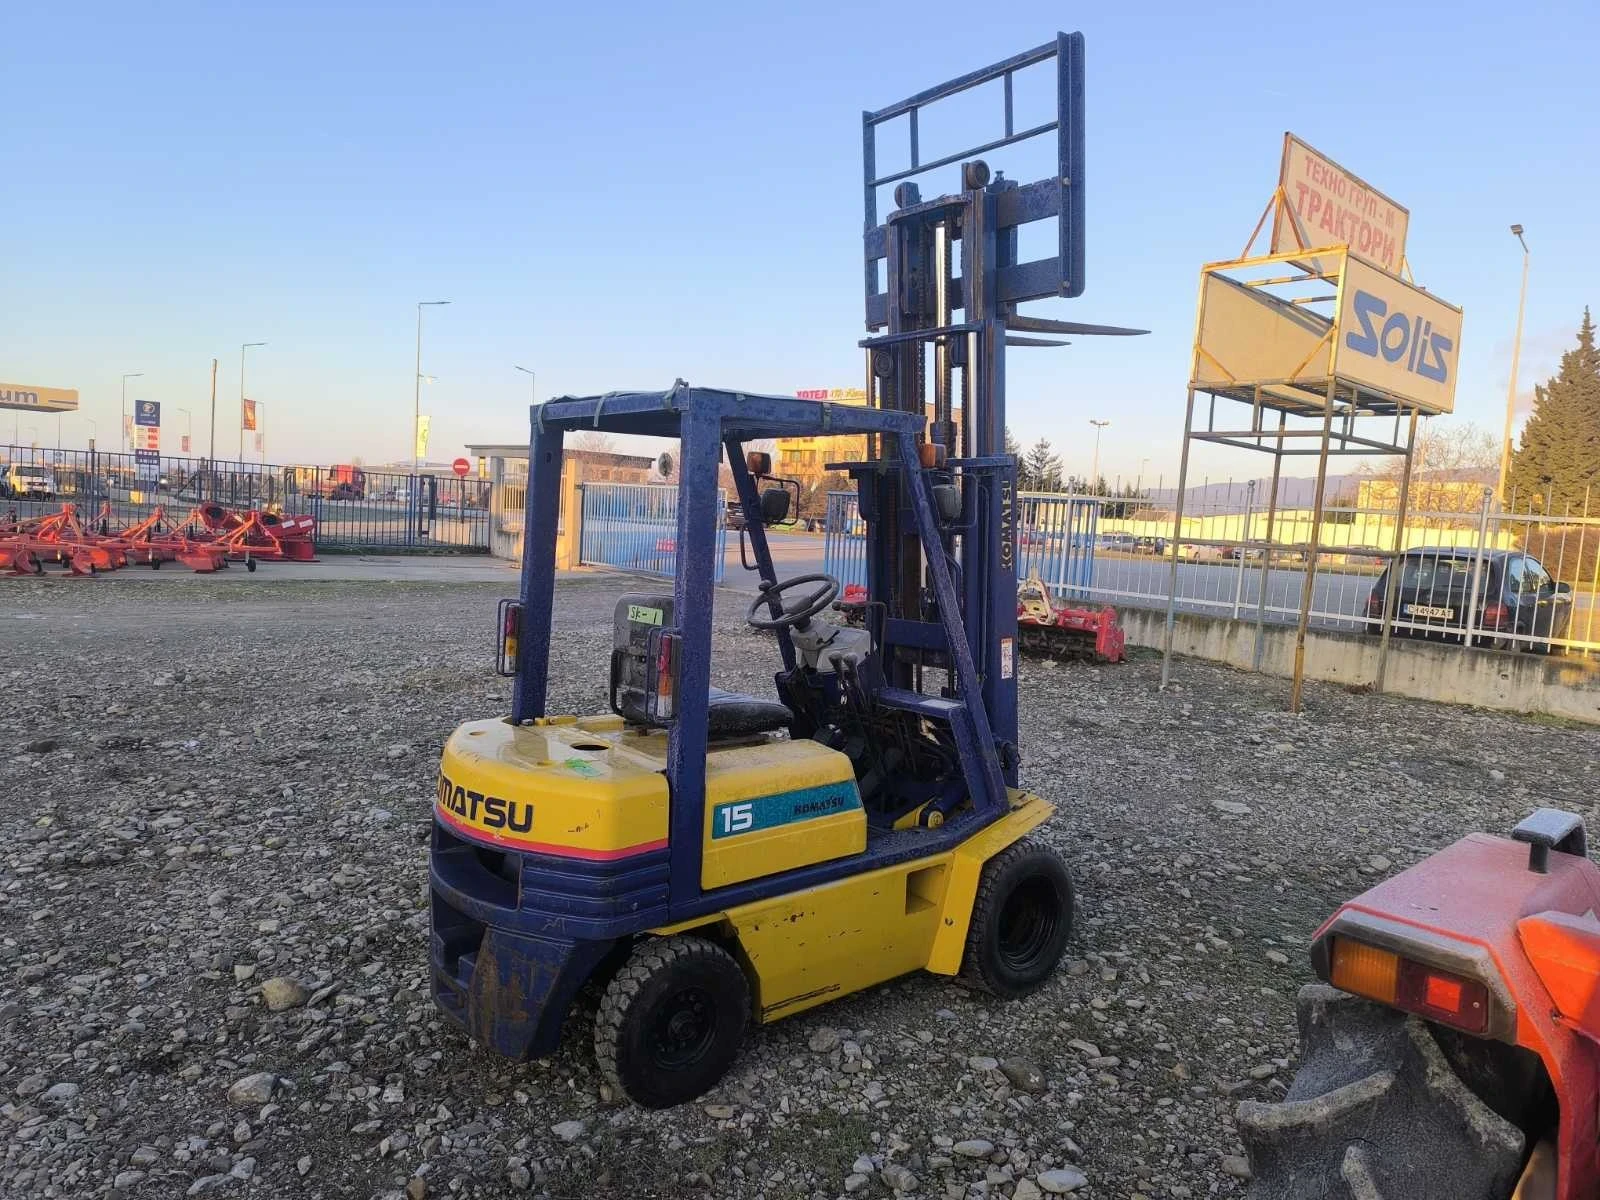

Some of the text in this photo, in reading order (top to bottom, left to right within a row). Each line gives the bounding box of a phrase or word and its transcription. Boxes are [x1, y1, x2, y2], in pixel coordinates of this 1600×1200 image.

[1305, 156, 1346, 198] ТЕХНО
[1295, 180, 1396, 266] ТРАКТОРИ
[721, 796, 844, 833] 15 KOMATSU
